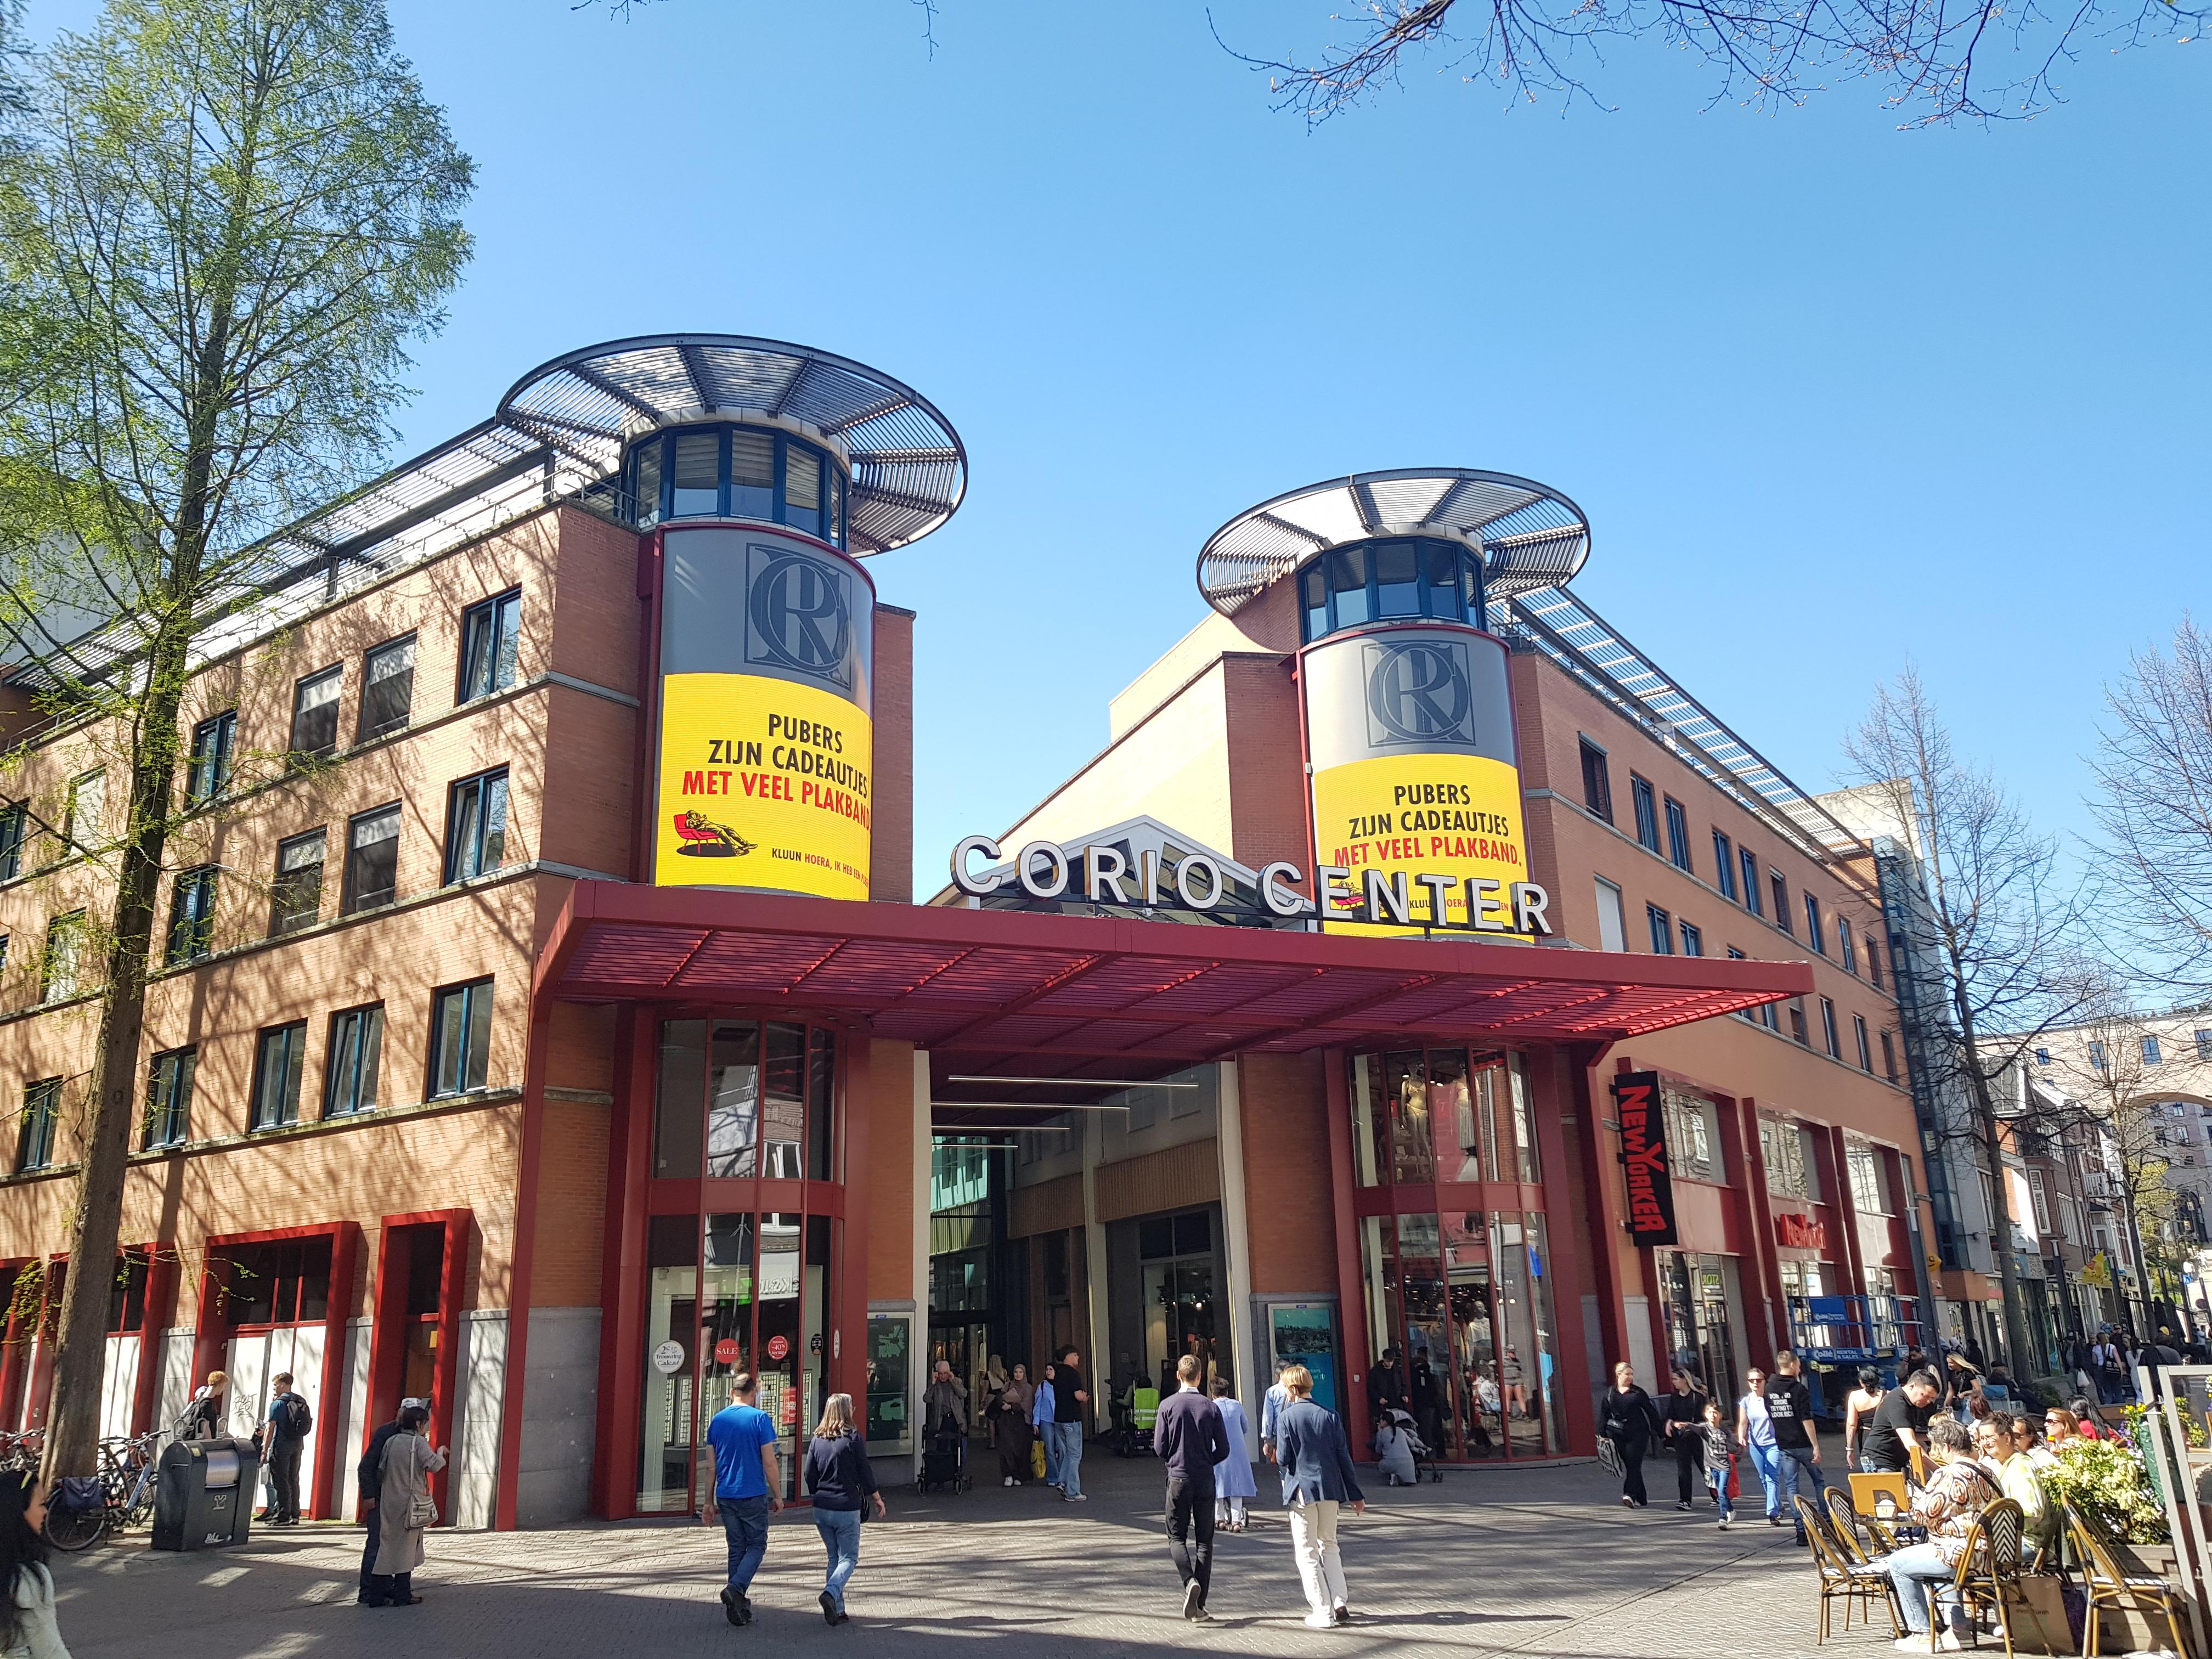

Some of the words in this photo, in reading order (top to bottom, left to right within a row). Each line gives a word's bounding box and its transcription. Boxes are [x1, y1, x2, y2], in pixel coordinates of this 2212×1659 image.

[768, 713, 843, 754] PUBERS
[708, 740, 763, 767] ZIJN
[772, 746, 868, 799] CADEAUTJES
[682, 771, 730, 795] MET
[741, 772, 794, 802] VEEL
[802, 781, 870, 831] PLAKBAND
[1394, 784, 1471, 806] PUBERS
[1349, 814, 1392, 839] ZIJN
[1401, 810, 1509, 837] CADEAUTJES
[772, 848, 802, 862] KLUUN
[805, 853, 832, 871] HOERA,
[834, 861, 841, 872] IK
[843, 863, 853, 876] HEB
[1334, 842, 1369, 867] MET
[1375, 837, 1424, 861] VEEL
[1431, 836, 1522, 867] PLAKBAND.
[951, 835, 1223, 910] CORIO
[1256, 861, 1553, 936] CENTER
[1409, 899, 1431, 909] KLUU
